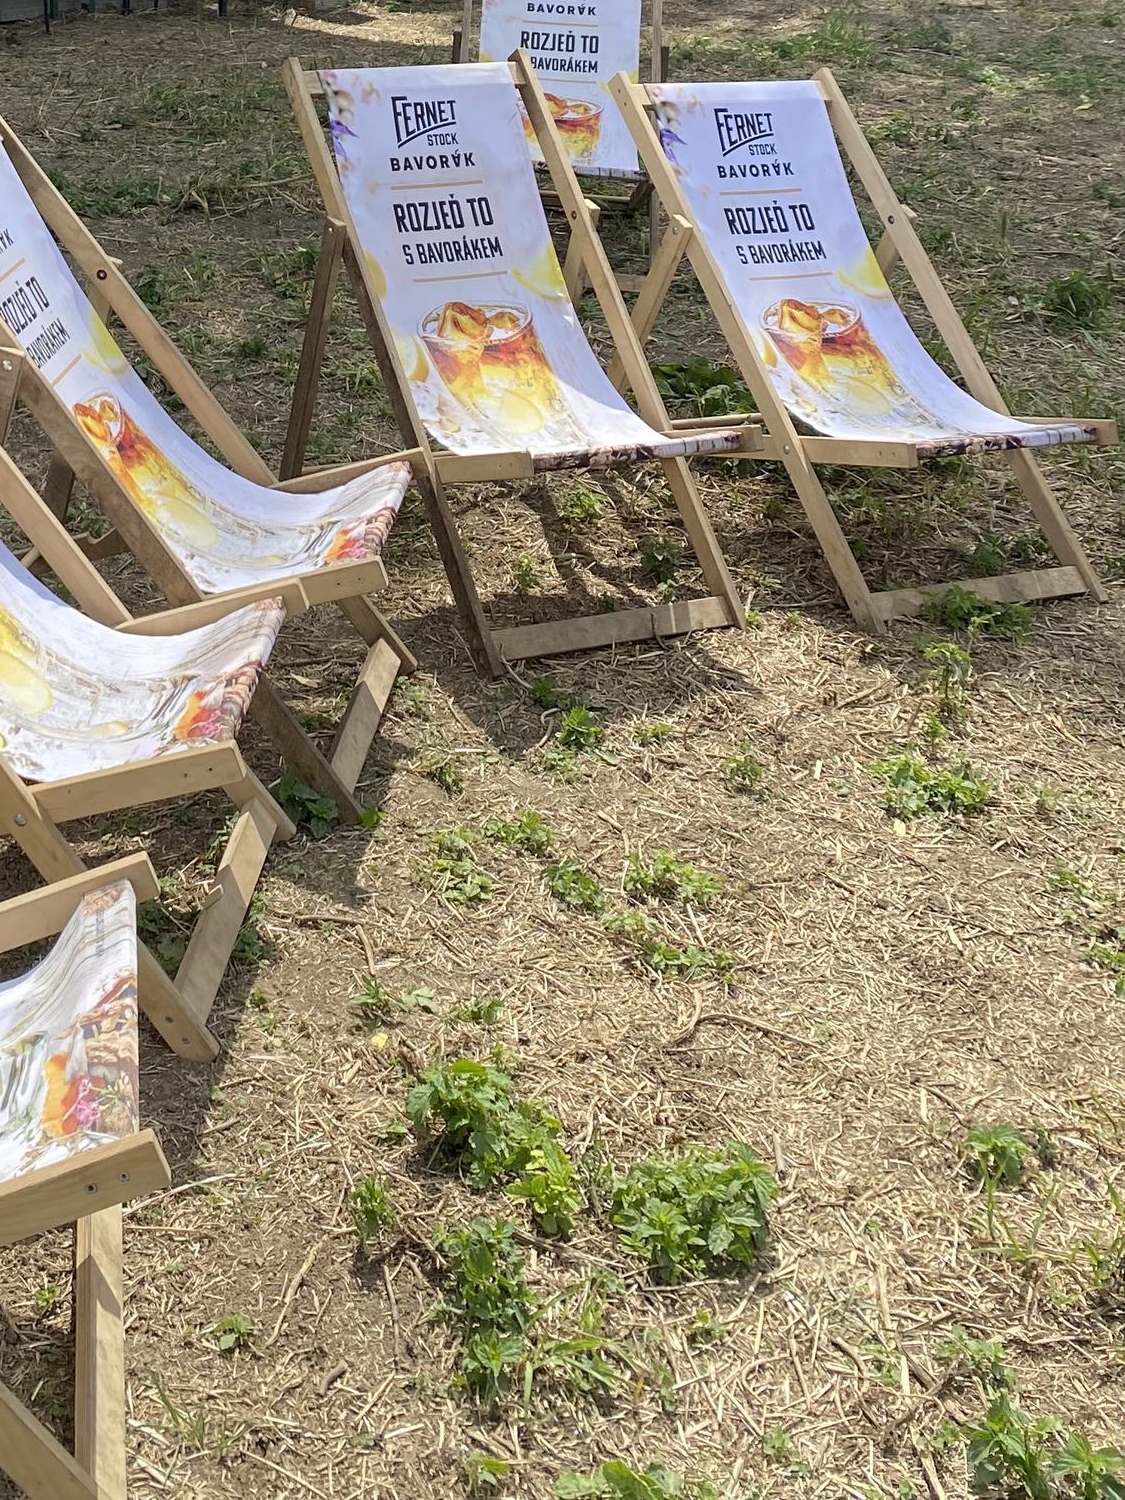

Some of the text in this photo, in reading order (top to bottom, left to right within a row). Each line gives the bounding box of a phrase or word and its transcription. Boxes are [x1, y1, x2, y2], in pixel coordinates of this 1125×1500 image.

[520, 31, 599, 53] ROZJEĎ TO
[391, 96, 456, 144] FERNET
[714, 108, 774, 153] FERNET
[427, 133, 459, 147] STOCK
[749, 143, 777, 156] STOCK
[393, 194, 495, 233] ROZJEĎ TO
[724, 200, 816, 235] ROZJEĎ TO
[403, 235, 504, 265] S BAVORÁKEM
[737, 239, 827, 264] S BAVORÁKEM
[25, 276, 50, 312] TO
